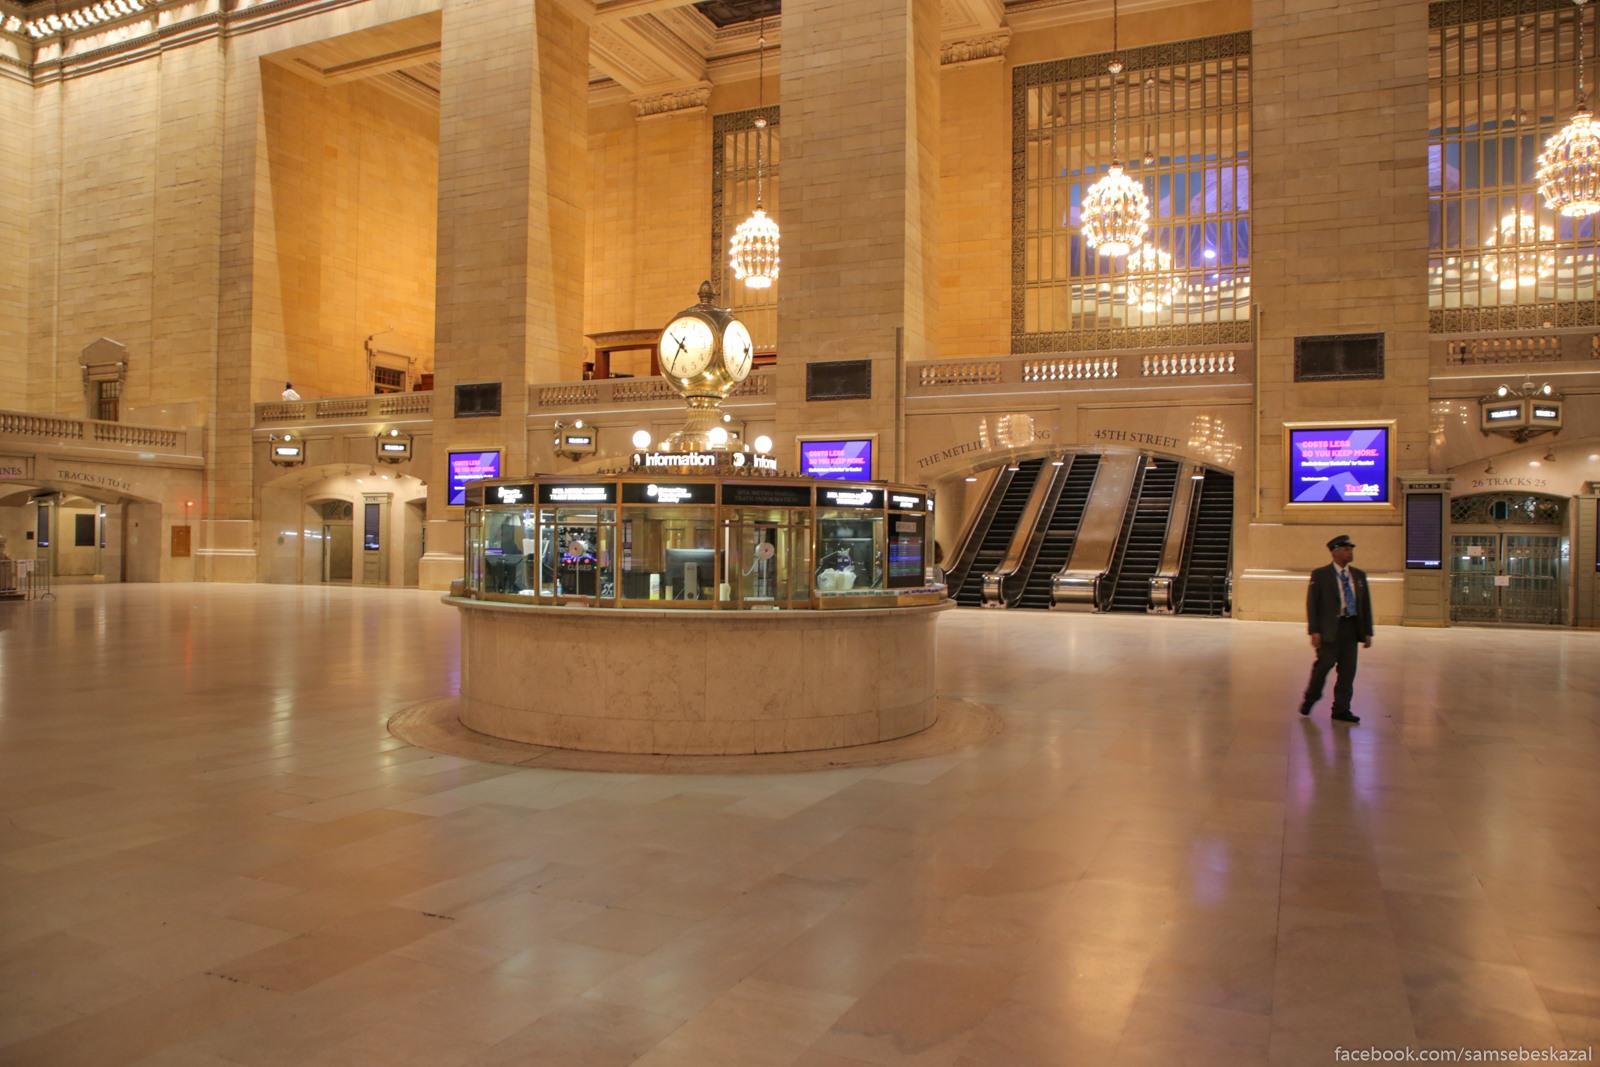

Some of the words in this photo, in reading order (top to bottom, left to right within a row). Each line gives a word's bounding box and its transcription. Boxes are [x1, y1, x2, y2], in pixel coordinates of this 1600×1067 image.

[1094, 429, 1126, 440] 45TH
[1130, 432, 1180, 448] STREET
[1302, 440, 1328, 448] COSTS
[1330, 440, 1350, 448] LESS
[646, 452, 715, 466] Information
[1302, 450, 1314, 458] SO
[1314, 450, 1330, 458] YOU
[1332, 449, 1353, 457] KEEP
[1354, 448, 1379, 457] MORE.
[916, 453, 941, 469] THE
[58, 470, 95, 482] TRACKS
[107, 478, 120, 488] TO
[1472, 480, 1484, 488] 26
[1487, 478, 1532, 487] TRACKS
[1534, 480, 1546, 488] 25
